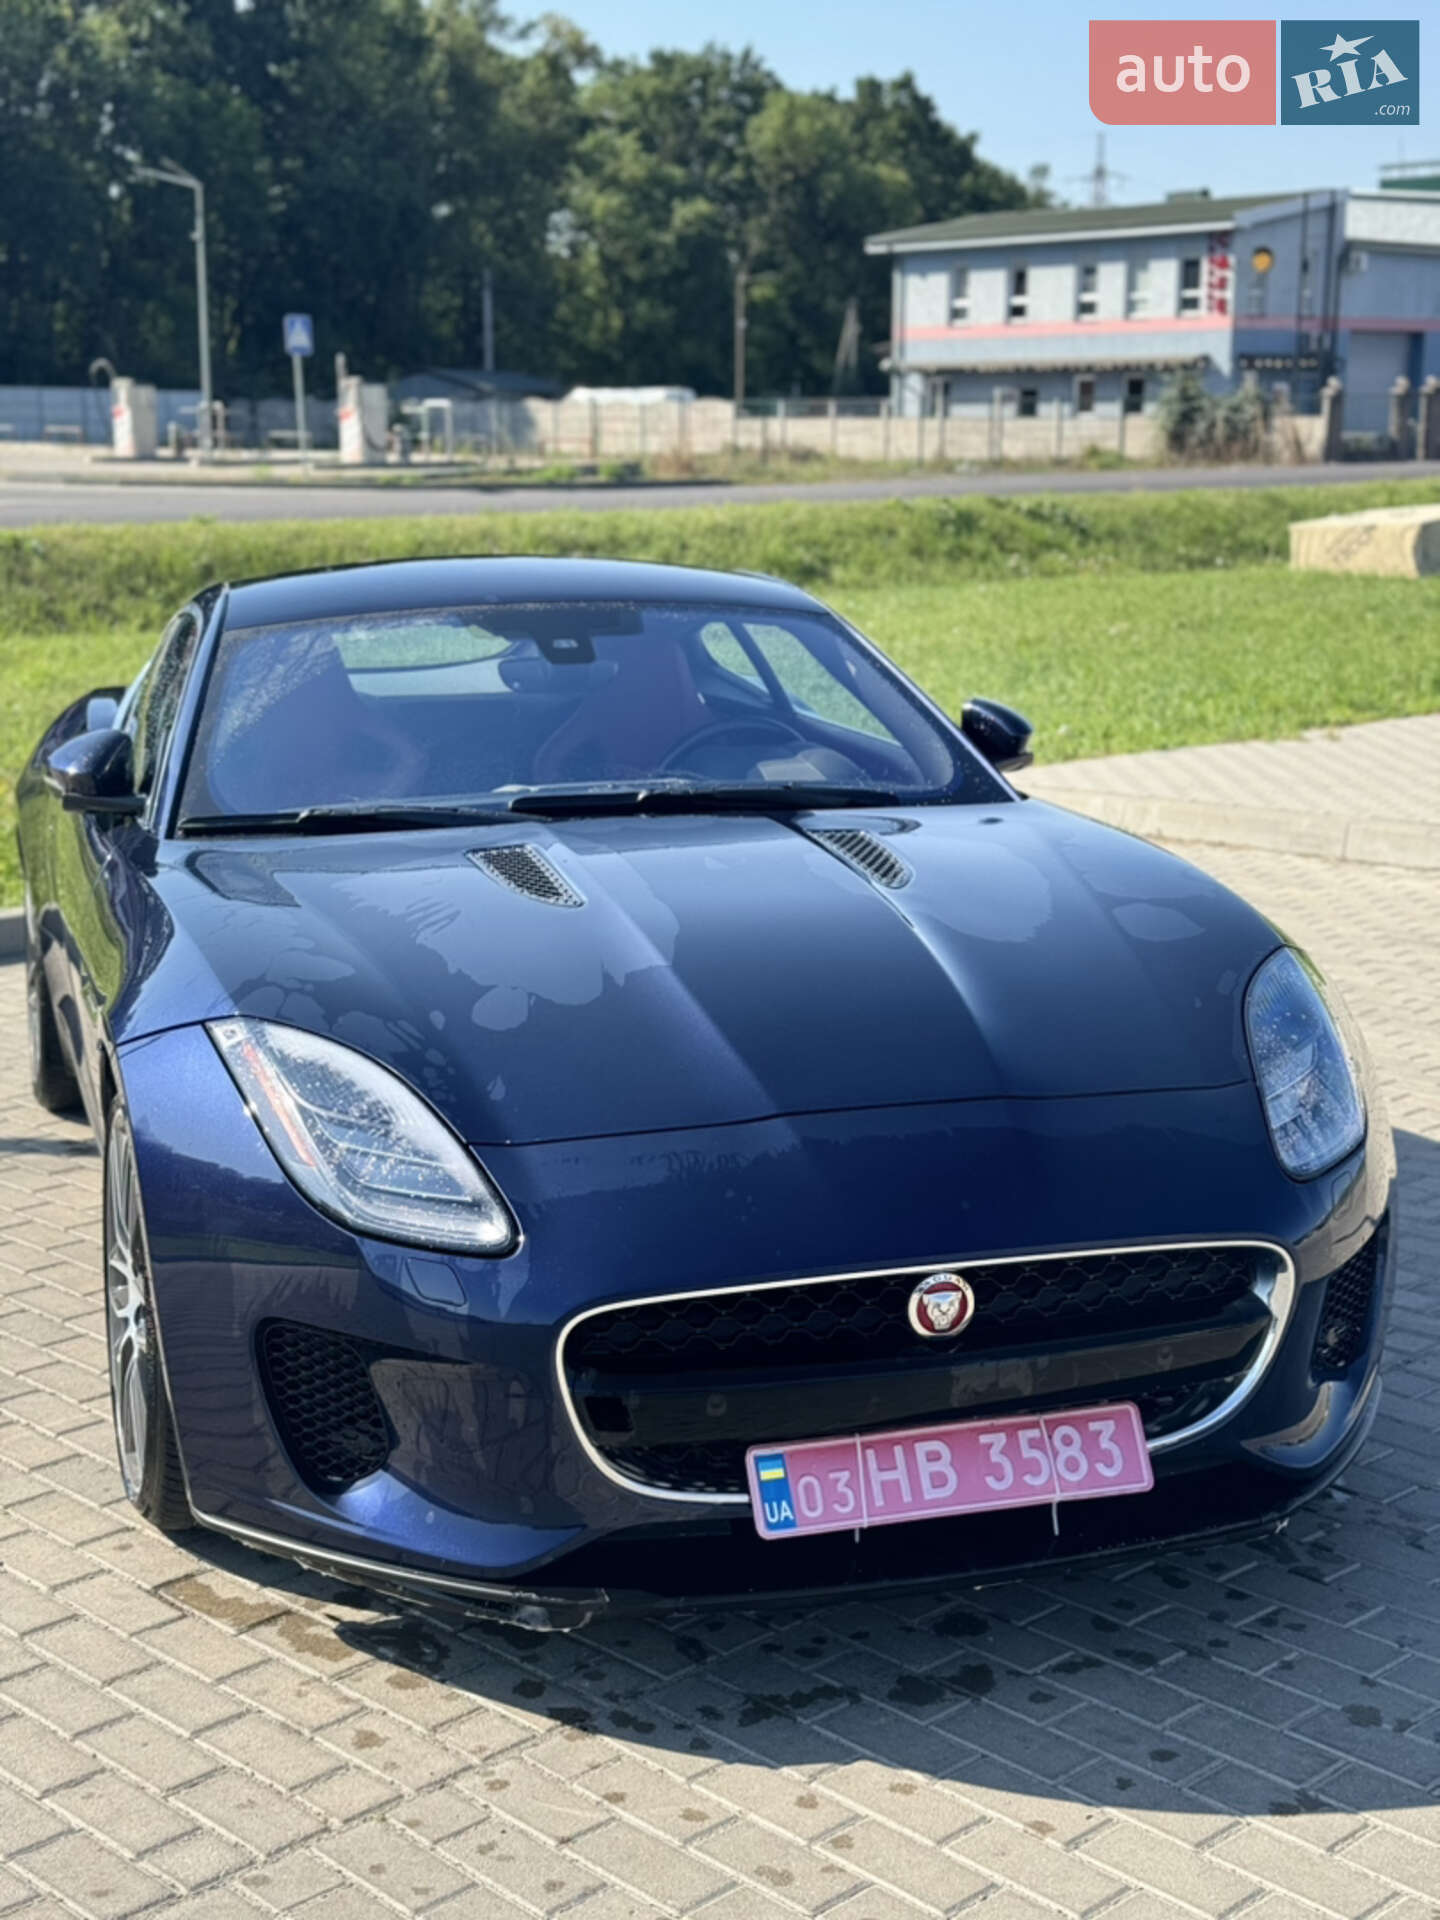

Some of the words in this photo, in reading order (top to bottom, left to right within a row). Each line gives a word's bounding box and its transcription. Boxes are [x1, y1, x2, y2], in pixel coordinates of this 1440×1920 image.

[797, 1473, 856, 1519] 03
[865, 1440, 959, 1507] HB
[979, 1419, 1124, 1491] 3583
[764, 1499, 794, 1525] UA
